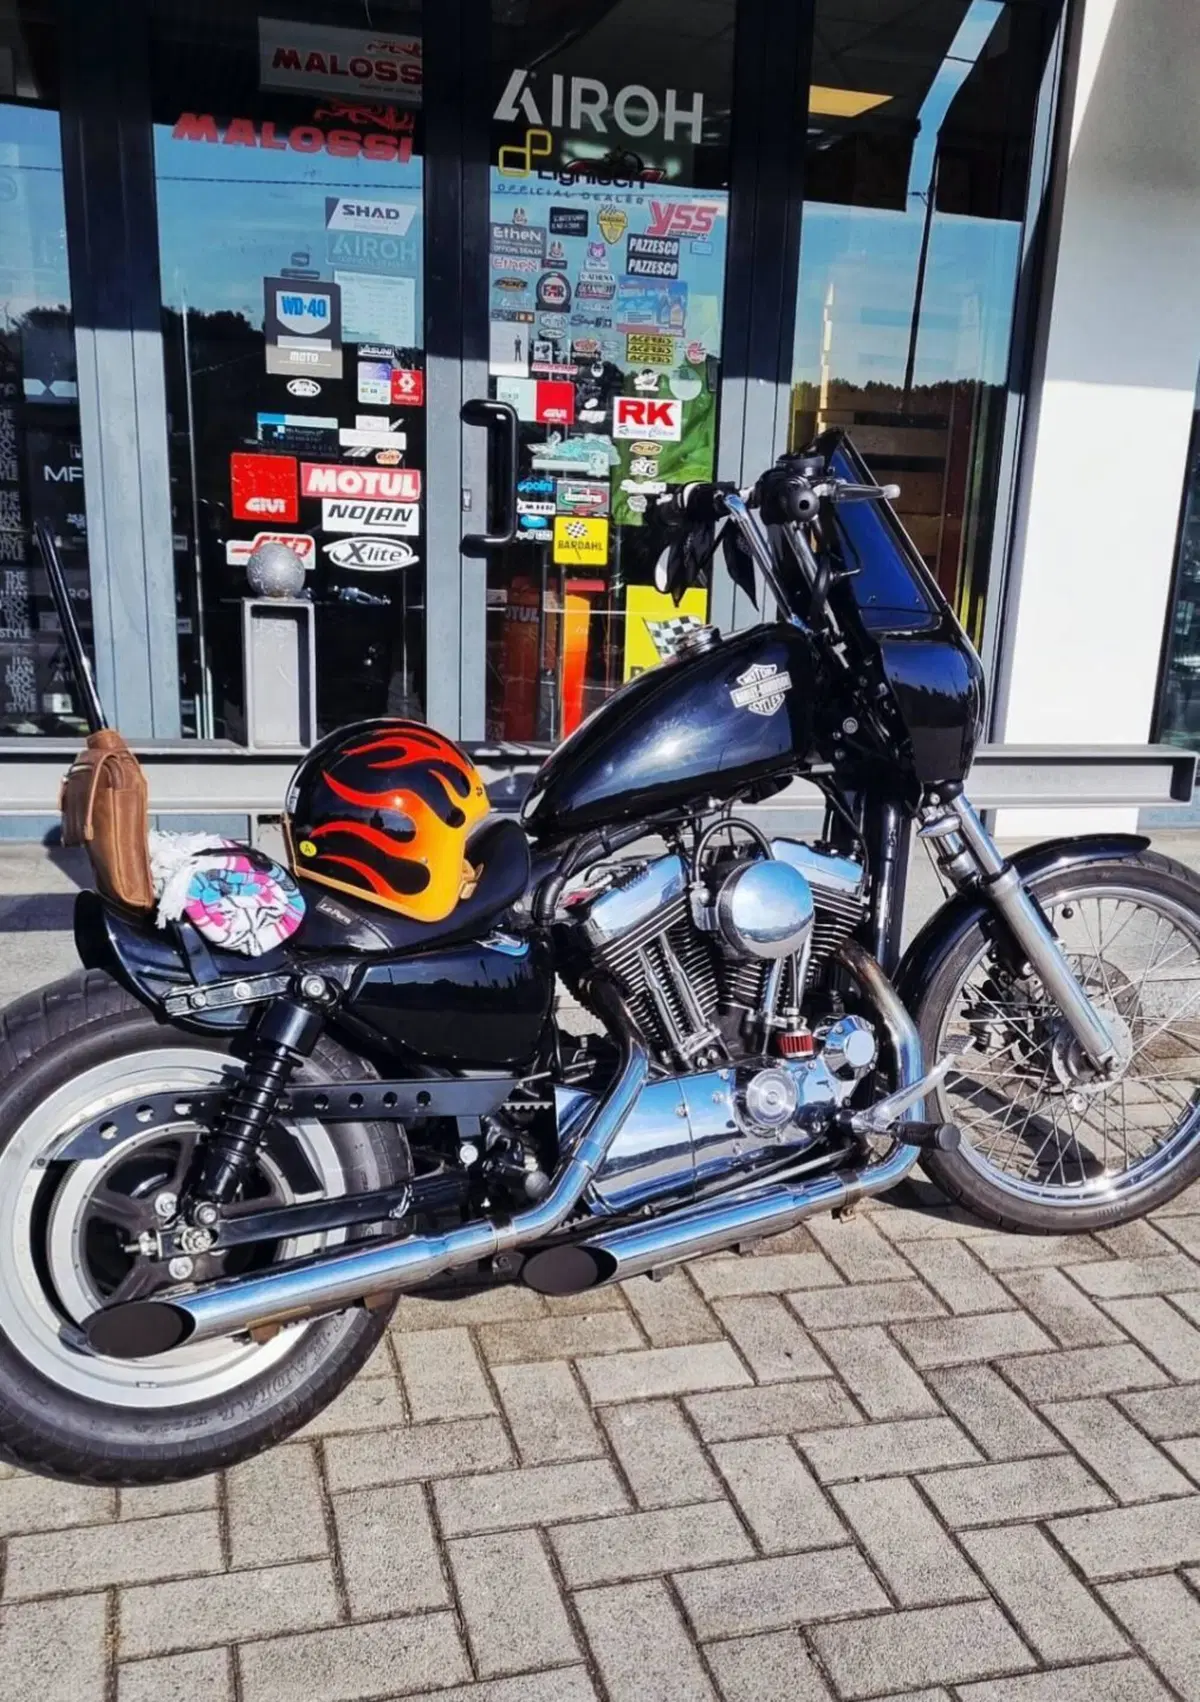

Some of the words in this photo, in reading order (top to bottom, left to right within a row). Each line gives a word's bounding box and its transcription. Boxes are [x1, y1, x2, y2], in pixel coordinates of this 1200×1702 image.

[273, 48, 422, 84] MALOSS
[493, 69, 704, 144] AIROH
[172, 112, 413, 164] MALOSSI
[342, 203, 400, 221] SHAD
[332, 233, 418, 262] AIROH
[629, 238, 679, 255] PAZZESCO
[628, 258, 678, 276] PAZZESCO
[289, 352, 319, 363] MOTO
[618, 400, 674, 426] RK
[306, 467, 417, 497] MOTUL
[328, 504, 412, 527] NOLAN
[343, 543, 402, 564] X-lite
[557, 539, 603, 552] BARDAHL
